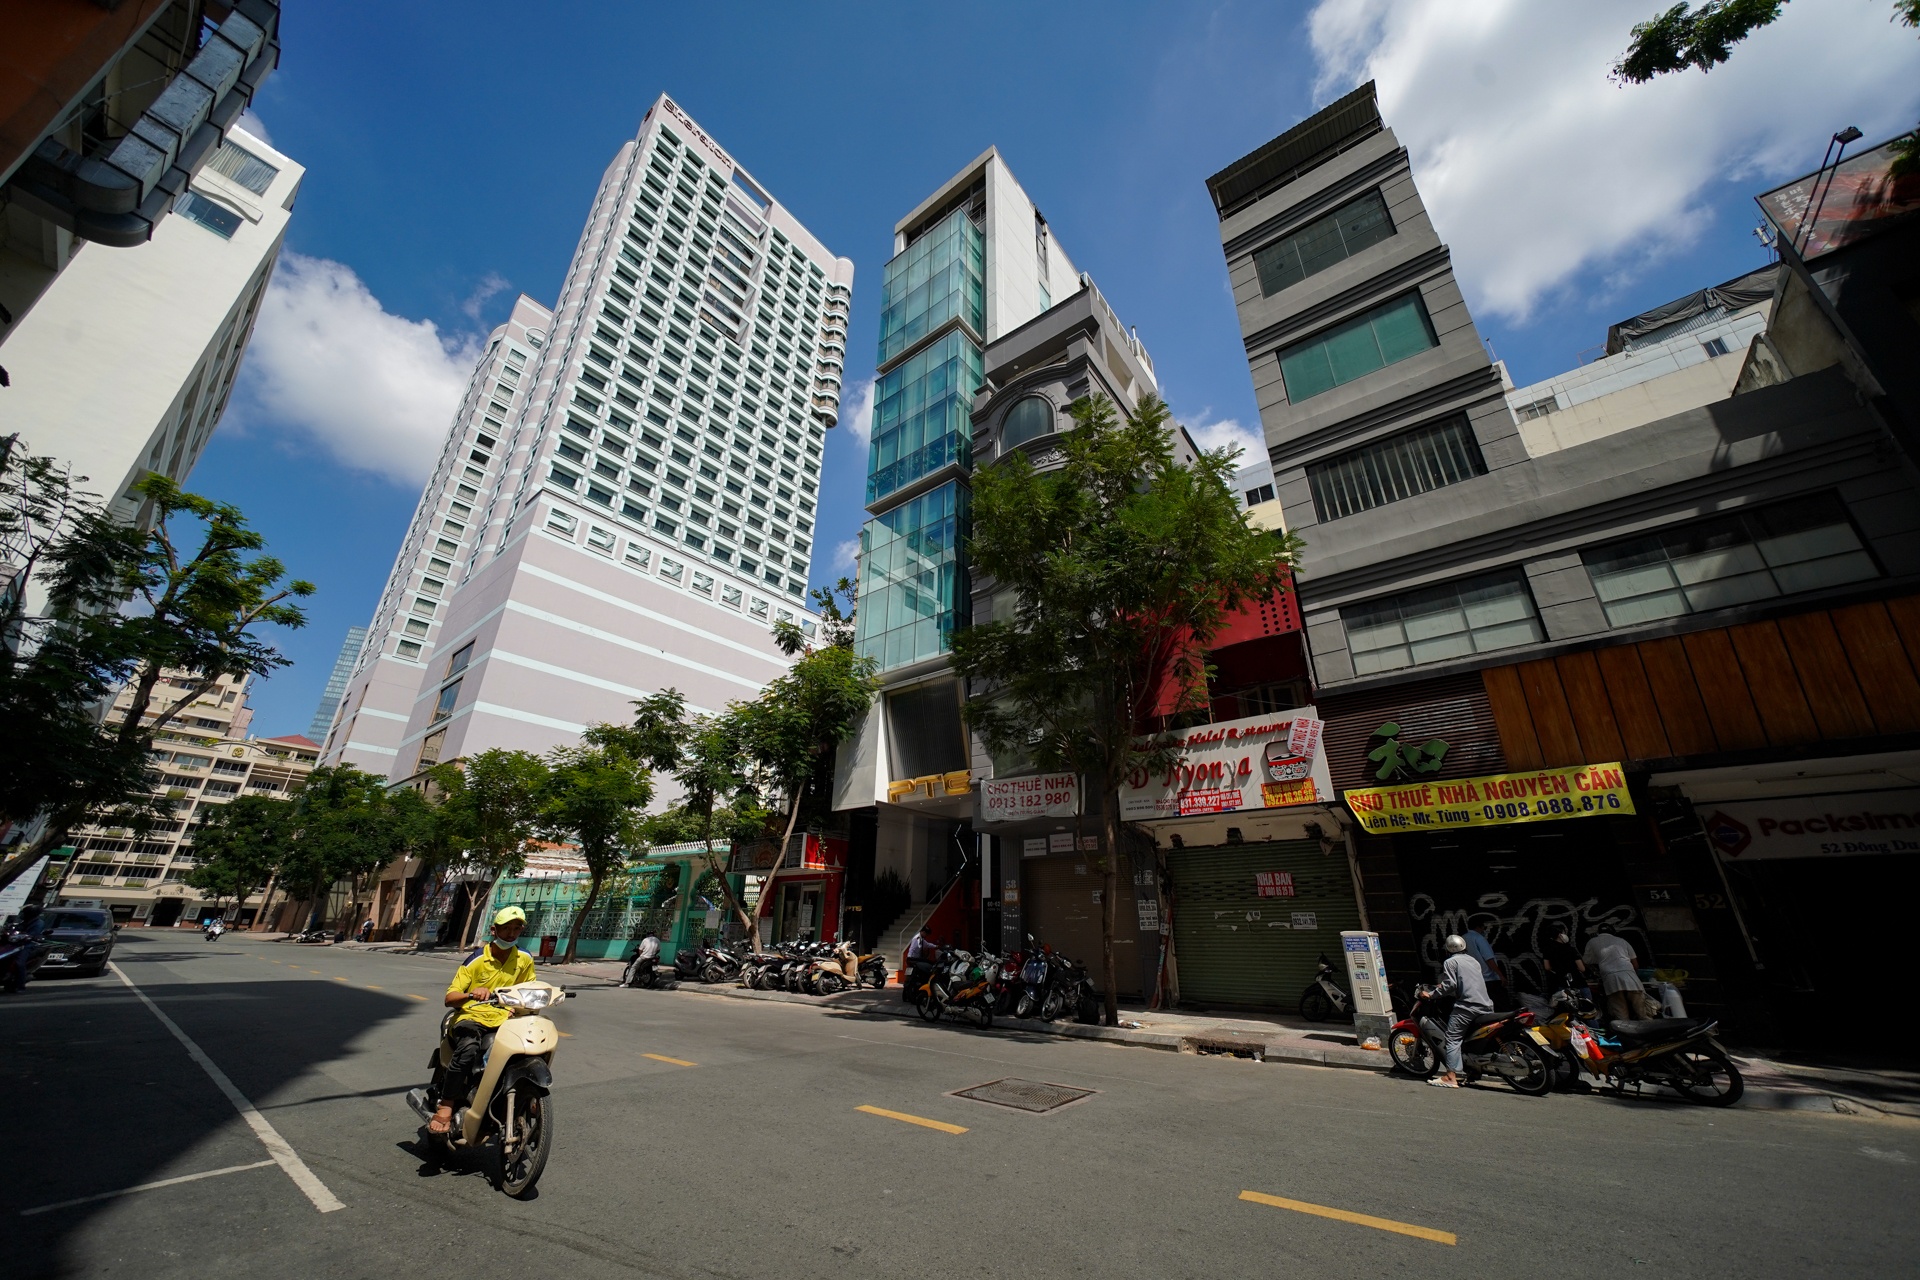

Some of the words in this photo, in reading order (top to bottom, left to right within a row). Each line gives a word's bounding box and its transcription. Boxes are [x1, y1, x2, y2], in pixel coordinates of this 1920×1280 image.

[662, 98, 732, 169] Sheraton
[1187, 727, 1226, 747] Halal
[987, 783, 1009, 795] CHO
[1010, 777, 1041, 794] THUÊ
[1044, 774, 1075, 790] NHÀ
[1349, 791, 1384, 813] CHO
[1389, 781, 1434, 809] THUÊ
[1438, 779, 1479, 805] NHÀ
[1485, 771, 1569, 801] NGUYÊN
[1574, 766, 1624, 792] CĂN
[989, 796, 1016, 809] 0913
[1019, 794, 1042, 807] 182
[1045, 791, 1071, 805] 980
[1362, 812, 1388, 830] Liên
[1389, 812, 1411, 830] Hệ:
[1413, 811, 1435, 825] Mr.
[1436, 806, 1471, 825] Tùng
[1483, 793, 1621, 821] 0908.088.876
[1821, 843, 1841, 854] 52
[1844, 842, 1890, 854] Đông
[1650, 889, 1671, 900] 54
[1694, 893, 1727, 910] 52
